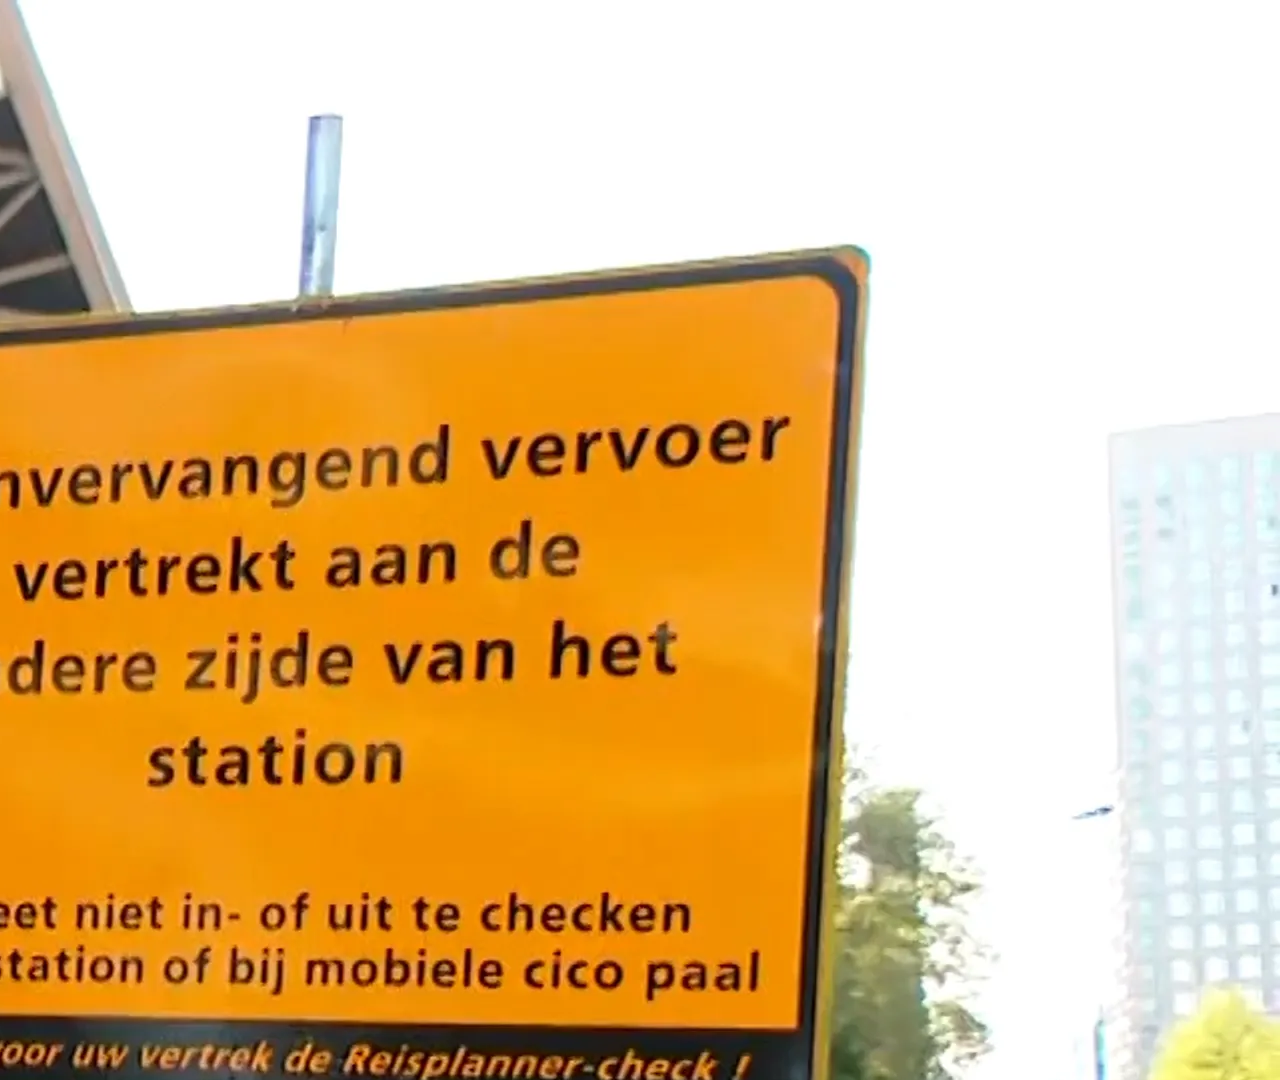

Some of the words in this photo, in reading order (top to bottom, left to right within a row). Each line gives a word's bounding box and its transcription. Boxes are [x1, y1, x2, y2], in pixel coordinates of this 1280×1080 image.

[481, 416, 790, 480] vervoer
[13, 536, 296, 602] vertrekt
[326, 542, 457, 589] aan
[490, 519, 580, 580] de
[185, 630, 354, 704] zijde
[383, 638, 515, 685] van
[550, 619, 677, 679] het
[147, 728, 403, 788] station
[76, 893, 163, 930] niet
[183, 892, 240, 931] in-
[260, 892, 309, 931] of
[328, 892, 393, 932] uit
[413, 897, 461, 933] te
[480, 891, 691, 933] checken
[163, 946, 212, 984] of
[229, 946, 284, 996] bij
[305, 947, 504, 990] mobiele
[524, 950, 624, 990] cico
[646, 950, 760, 1002] paal
[73, 1045, 129, 1068] uw
[141, 1040, 273, 1073] vertrek
[284, 1042, 332, 1073] de
